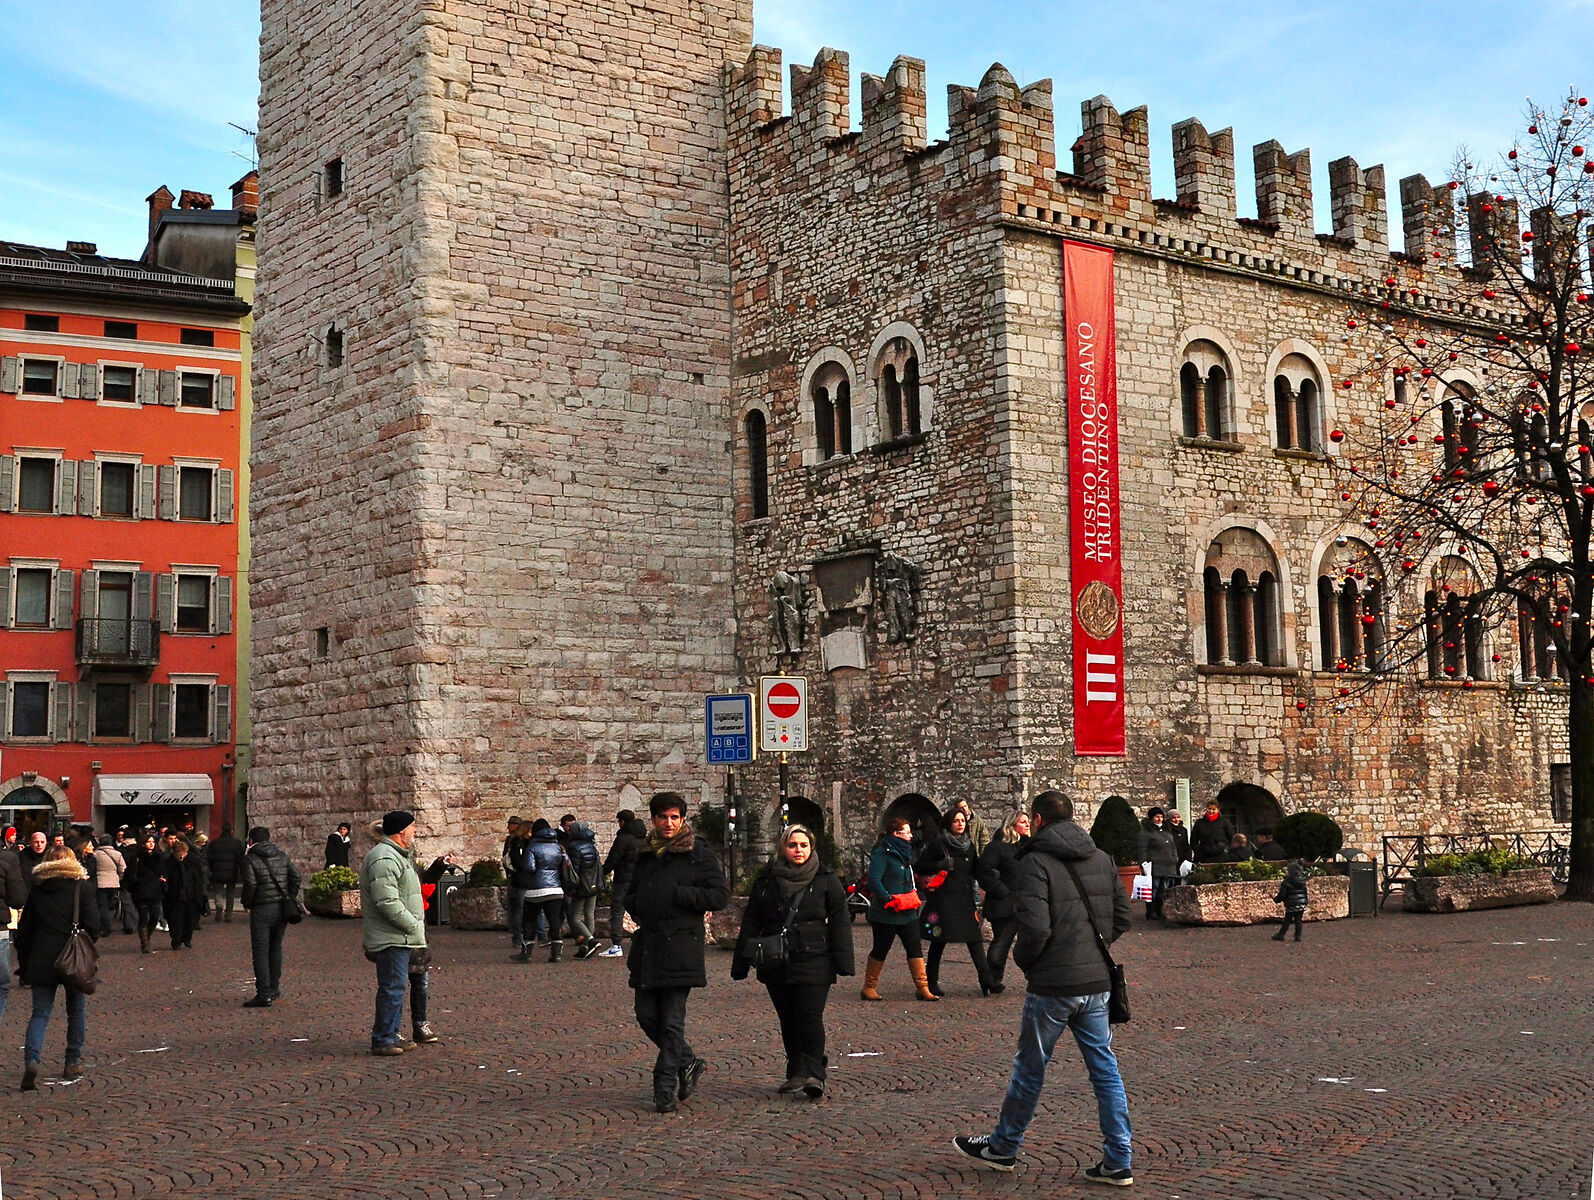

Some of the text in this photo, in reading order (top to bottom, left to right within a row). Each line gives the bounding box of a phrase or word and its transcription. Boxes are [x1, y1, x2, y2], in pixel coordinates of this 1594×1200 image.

[1077, 322, 1097, 561] MUSEO DIOCESANO
[1097, 402, 1112, 563] TRIDENTINO
[713, 738, 732, 747] A B
[149, 791, 197, 804] Danbi
